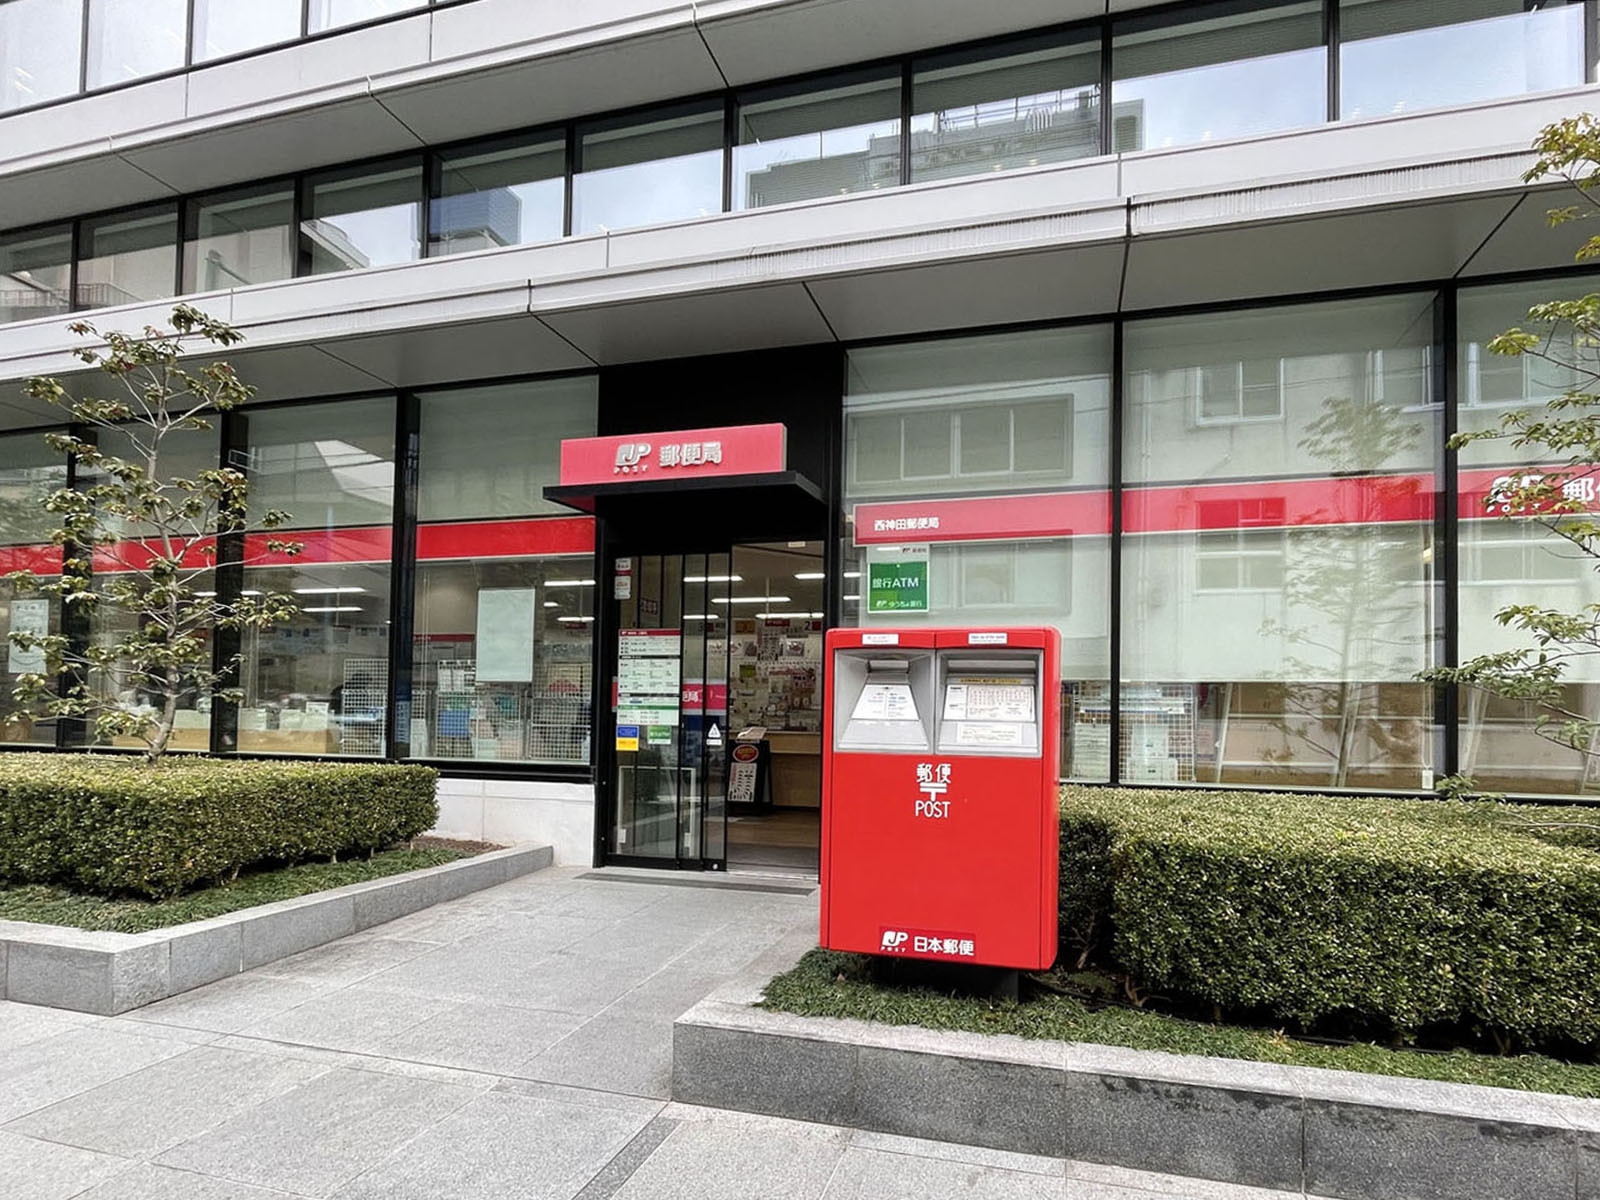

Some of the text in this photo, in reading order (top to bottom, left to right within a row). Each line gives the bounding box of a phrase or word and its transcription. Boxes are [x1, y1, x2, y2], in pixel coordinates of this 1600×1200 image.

[660, 441, 722, 467] 郵便局
[614, 465, 648, 474] POST
[1562, 477, 1600, 502] 郵
[874, 516, 940, 531] 西神田郵便局
[872, 577, 919, 589] 銀行ATM
[916, 763, 952, 783] 郵便
[915, 800, 951, 818] POST
[915, 937, 974, 956] 日本郵便
